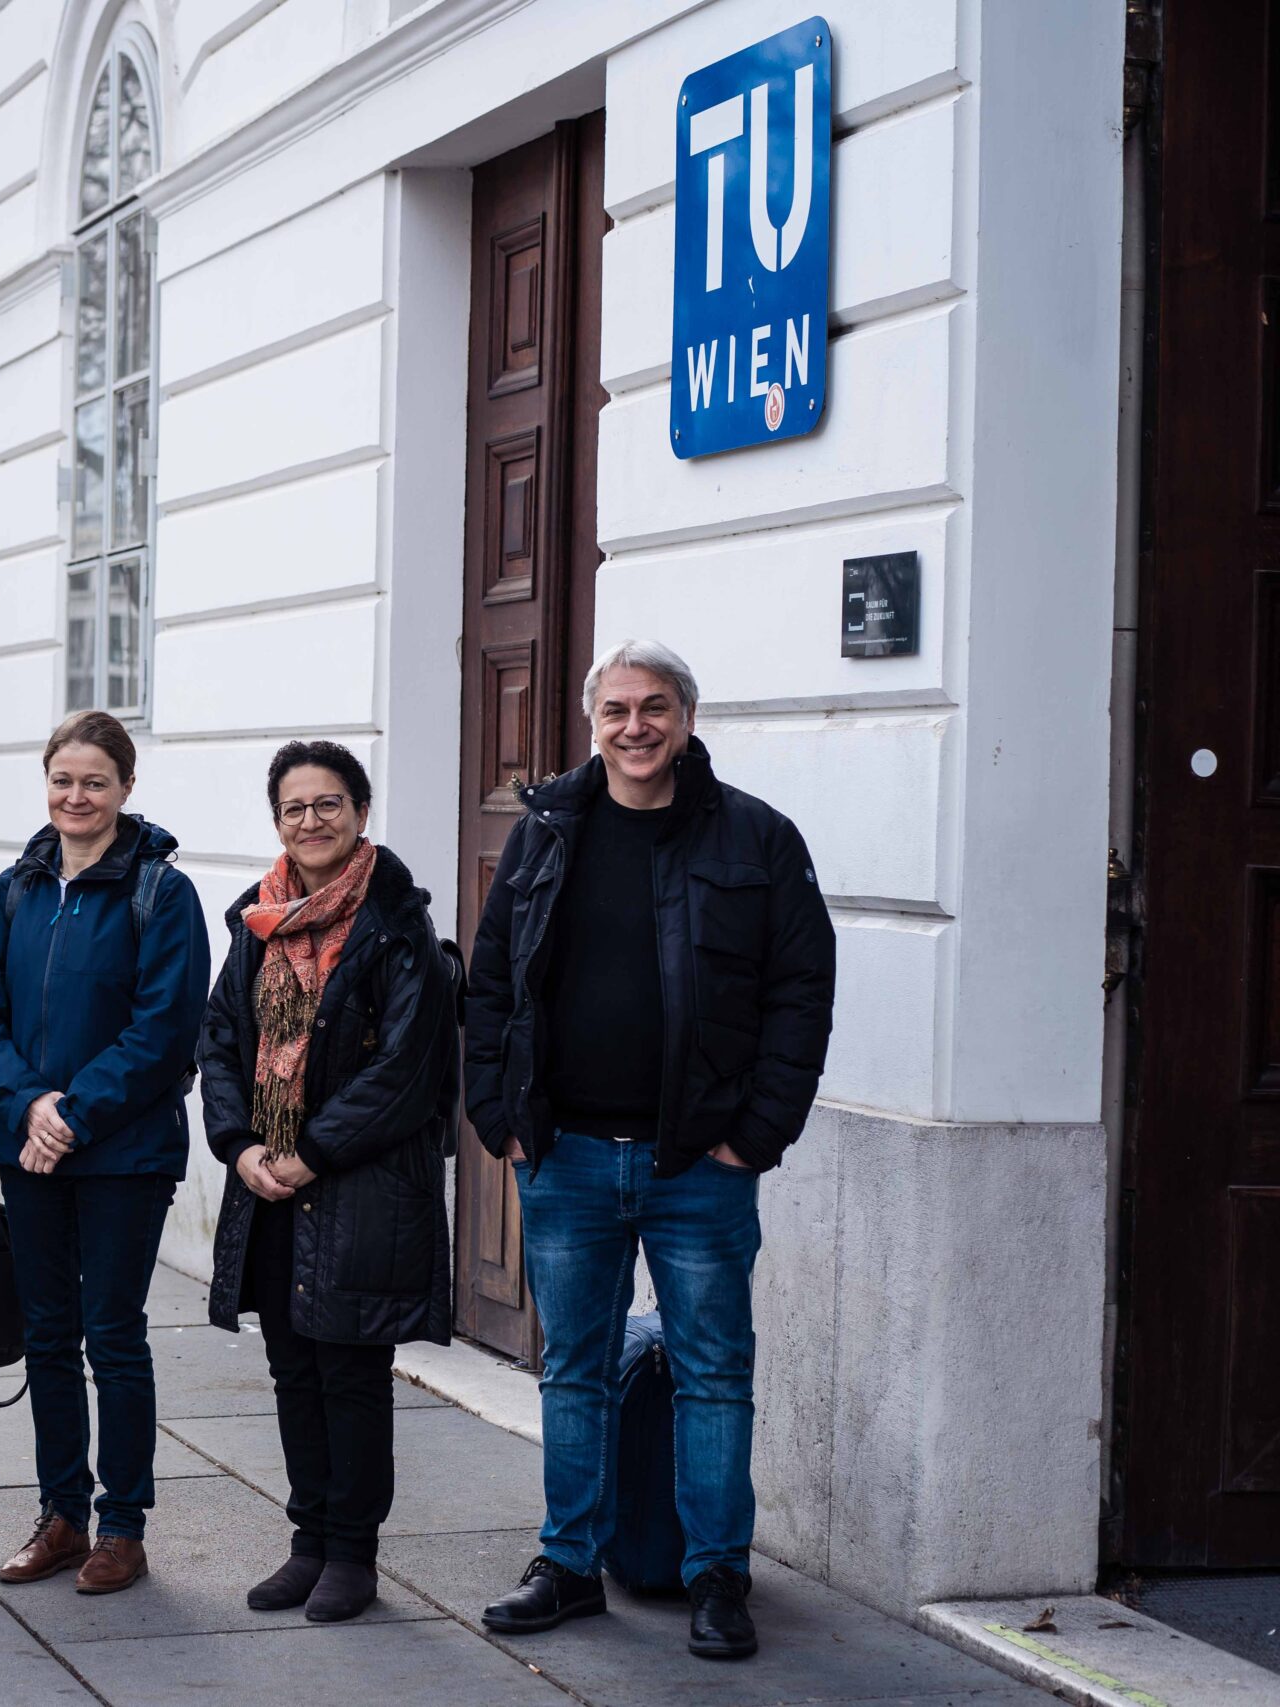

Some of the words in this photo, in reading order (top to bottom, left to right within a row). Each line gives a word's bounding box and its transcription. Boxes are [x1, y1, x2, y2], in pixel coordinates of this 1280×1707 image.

[690, 63, 814, 292] TU
[687, 314, 810, 412] WIEN
[873, 611, 895, 621] ZUKUNFT
[879, 598, 888, 608] FÜR
